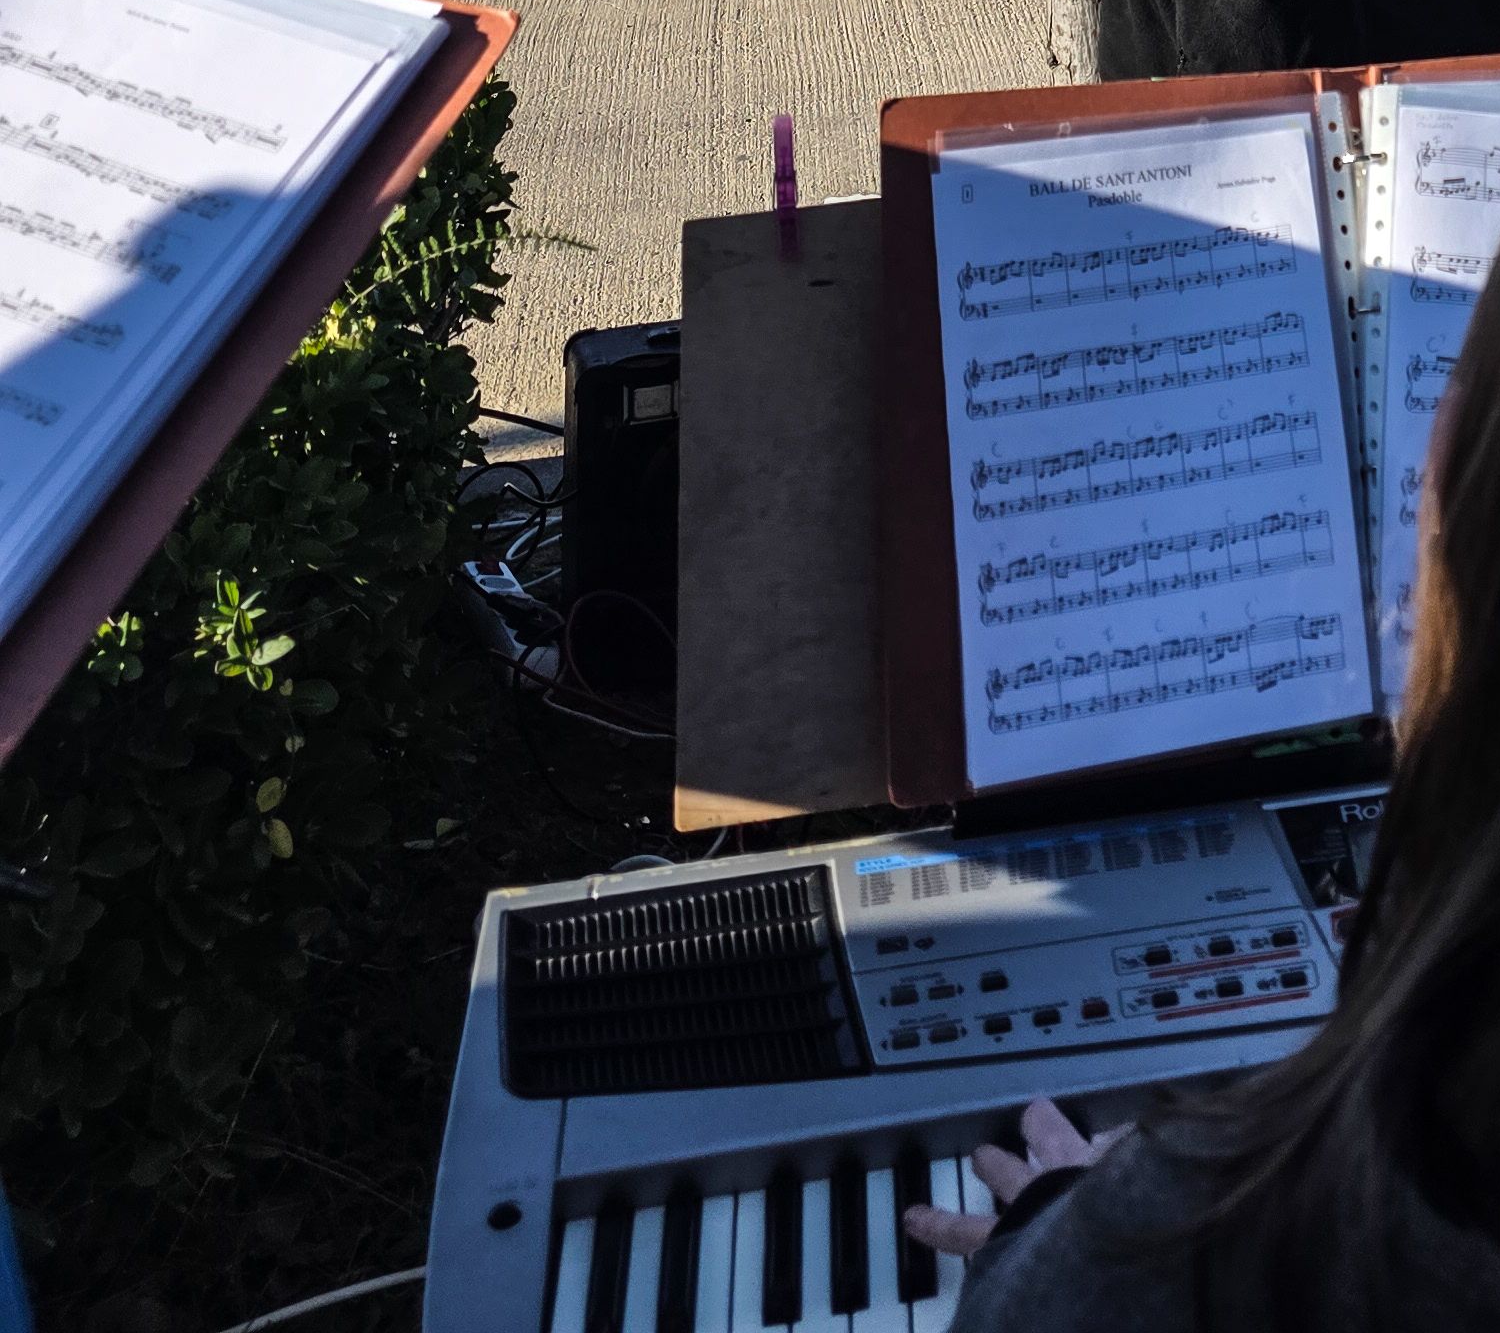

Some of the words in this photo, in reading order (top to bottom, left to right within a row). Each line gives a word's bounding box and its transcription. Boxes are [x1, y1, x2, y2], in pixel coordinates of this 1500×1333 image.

[1029, 179, 1070, 198] BALL
[1072, 177, 1093, 192] DE
[1095, 171, 1136, 189] SANT
[1137, 164, 1193, 184] ANTONI
[1088, 189, 1143, 209] Pasdoble
